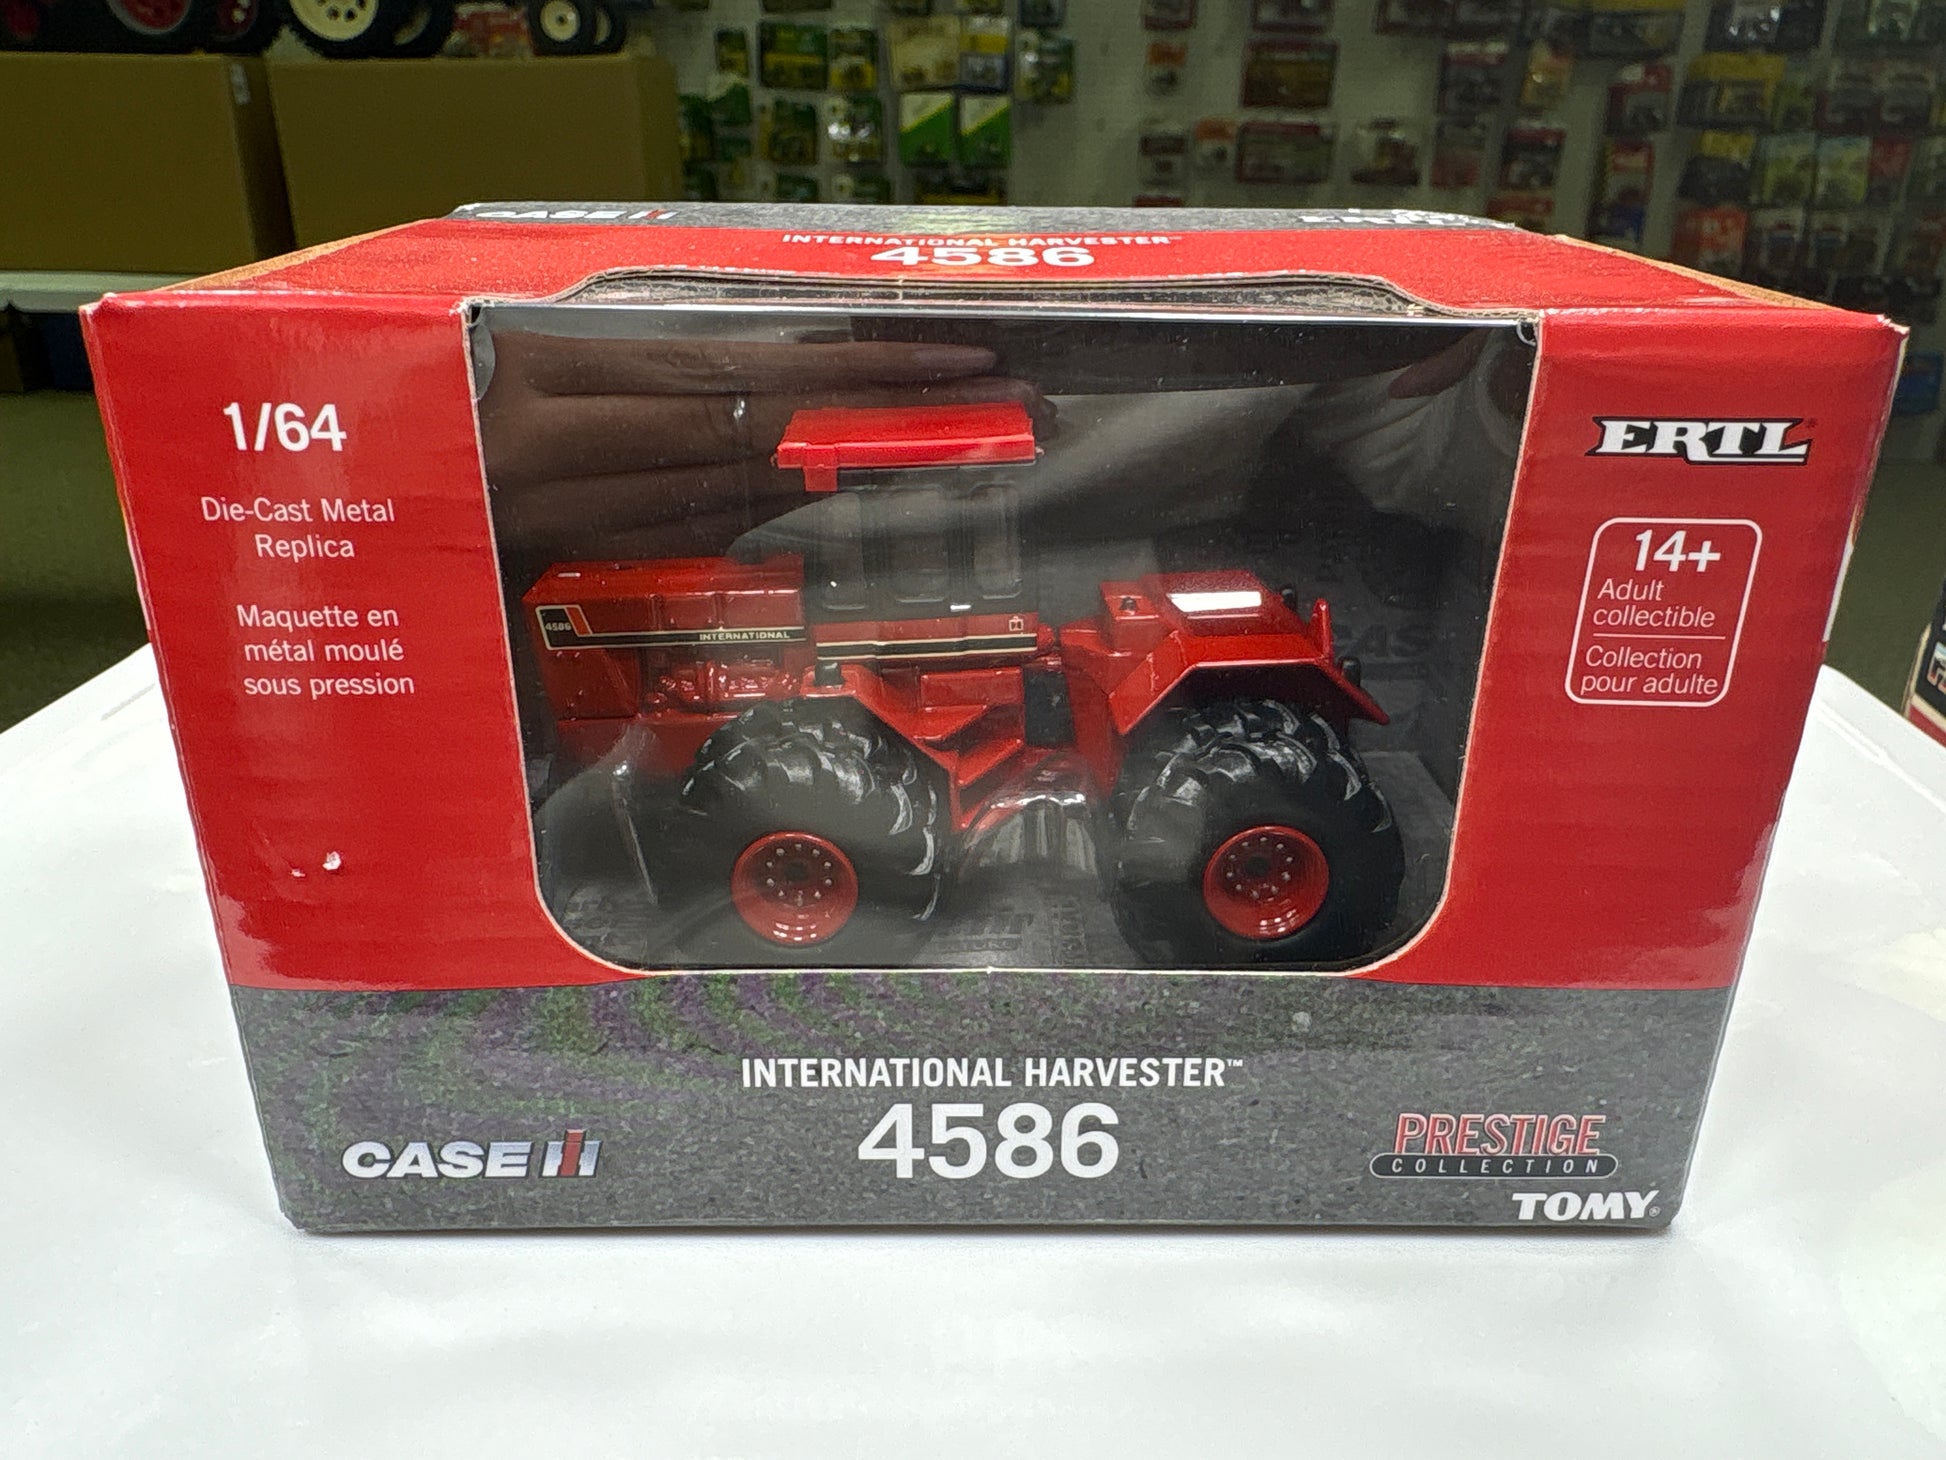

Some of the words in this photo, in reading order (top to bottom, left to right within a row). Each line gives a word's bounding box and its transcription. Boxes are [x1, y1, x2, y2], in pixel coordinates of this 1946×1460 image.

[781, 234, 999, 247] INTERNATIONAL
[869, 246, 1095, 267] 4586
[222, 401, 348, 452] 1/64
[200, 497, 313, 522] Die-Cast
[320, 498, 396, 523] Metal
[254, 533, 356, 563] Replica
[1634, 528, 1722, 573] 14+
[1596, 577, 1665, 602] Adult
[236, 604, 360, 633] Maquette
[366, 608, 400, 627] en
[1592, 604, 1716, 629] collectible
[699, 630, 791, 641] INTERNATIONAL
[243, 638, 315, 662] métal
[324, 638, 406, 662] moulé
[1584, 644, 1703, 670] Collection
[243, 676, 302, 696] sous
[309, 671, 415, 701] pression
[1580, 675, 1638, 696] pour
[1642, 674, 1719, 695] adulte
[741, 1057, 1012, 1089] INTERNATIONAL
[857, 1102, 1120, 1180] 4586
[1393, 1112, 1607, 1155] PRESTIGE
[341, 1140, 534, 1179] CASE
[1391, 1158, 1600, 1174] COLLECTION
